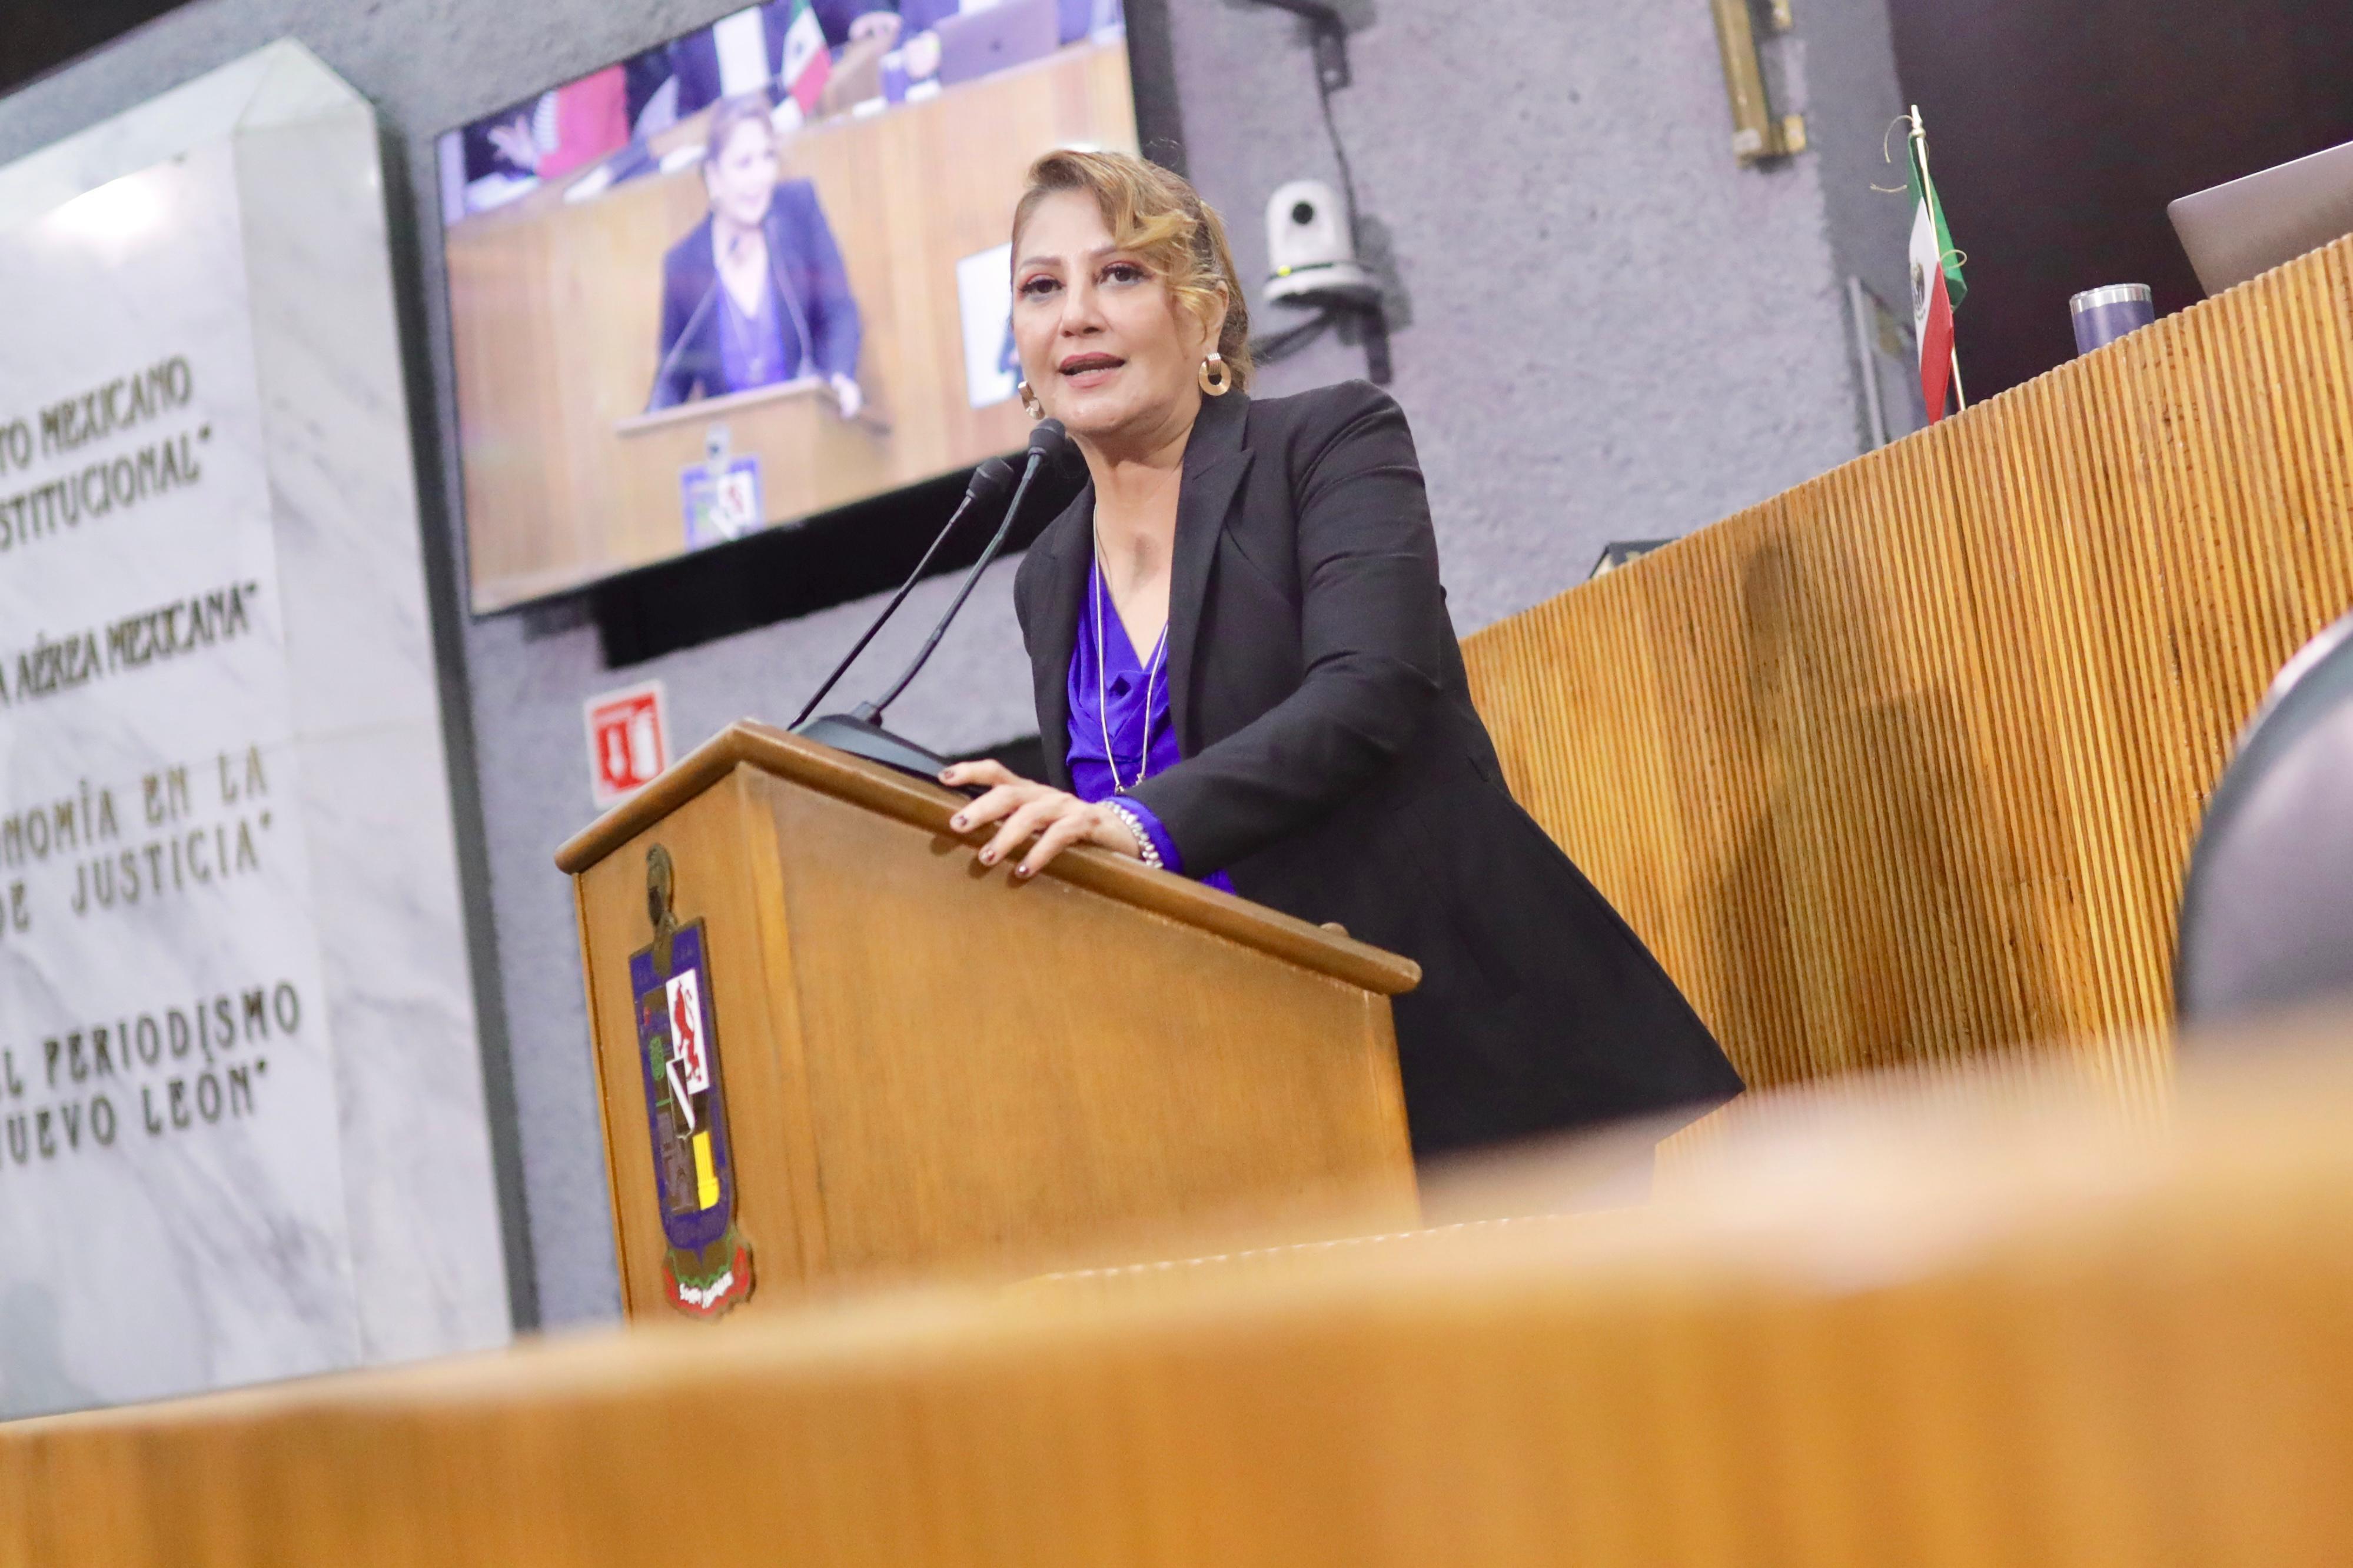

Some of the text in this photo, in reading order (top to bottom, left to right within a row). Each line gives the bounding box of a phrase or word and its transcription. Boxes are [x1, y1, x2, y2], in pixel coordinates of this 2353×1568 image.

[39, 354, 193, 458] MEXICANO
[142, 766, 191, 824] EN
[218, 744, 268, 805] LA
[44, 981, 300, 1087] PERIODISMO
[0, 1096, 117, 1170] UEVO
